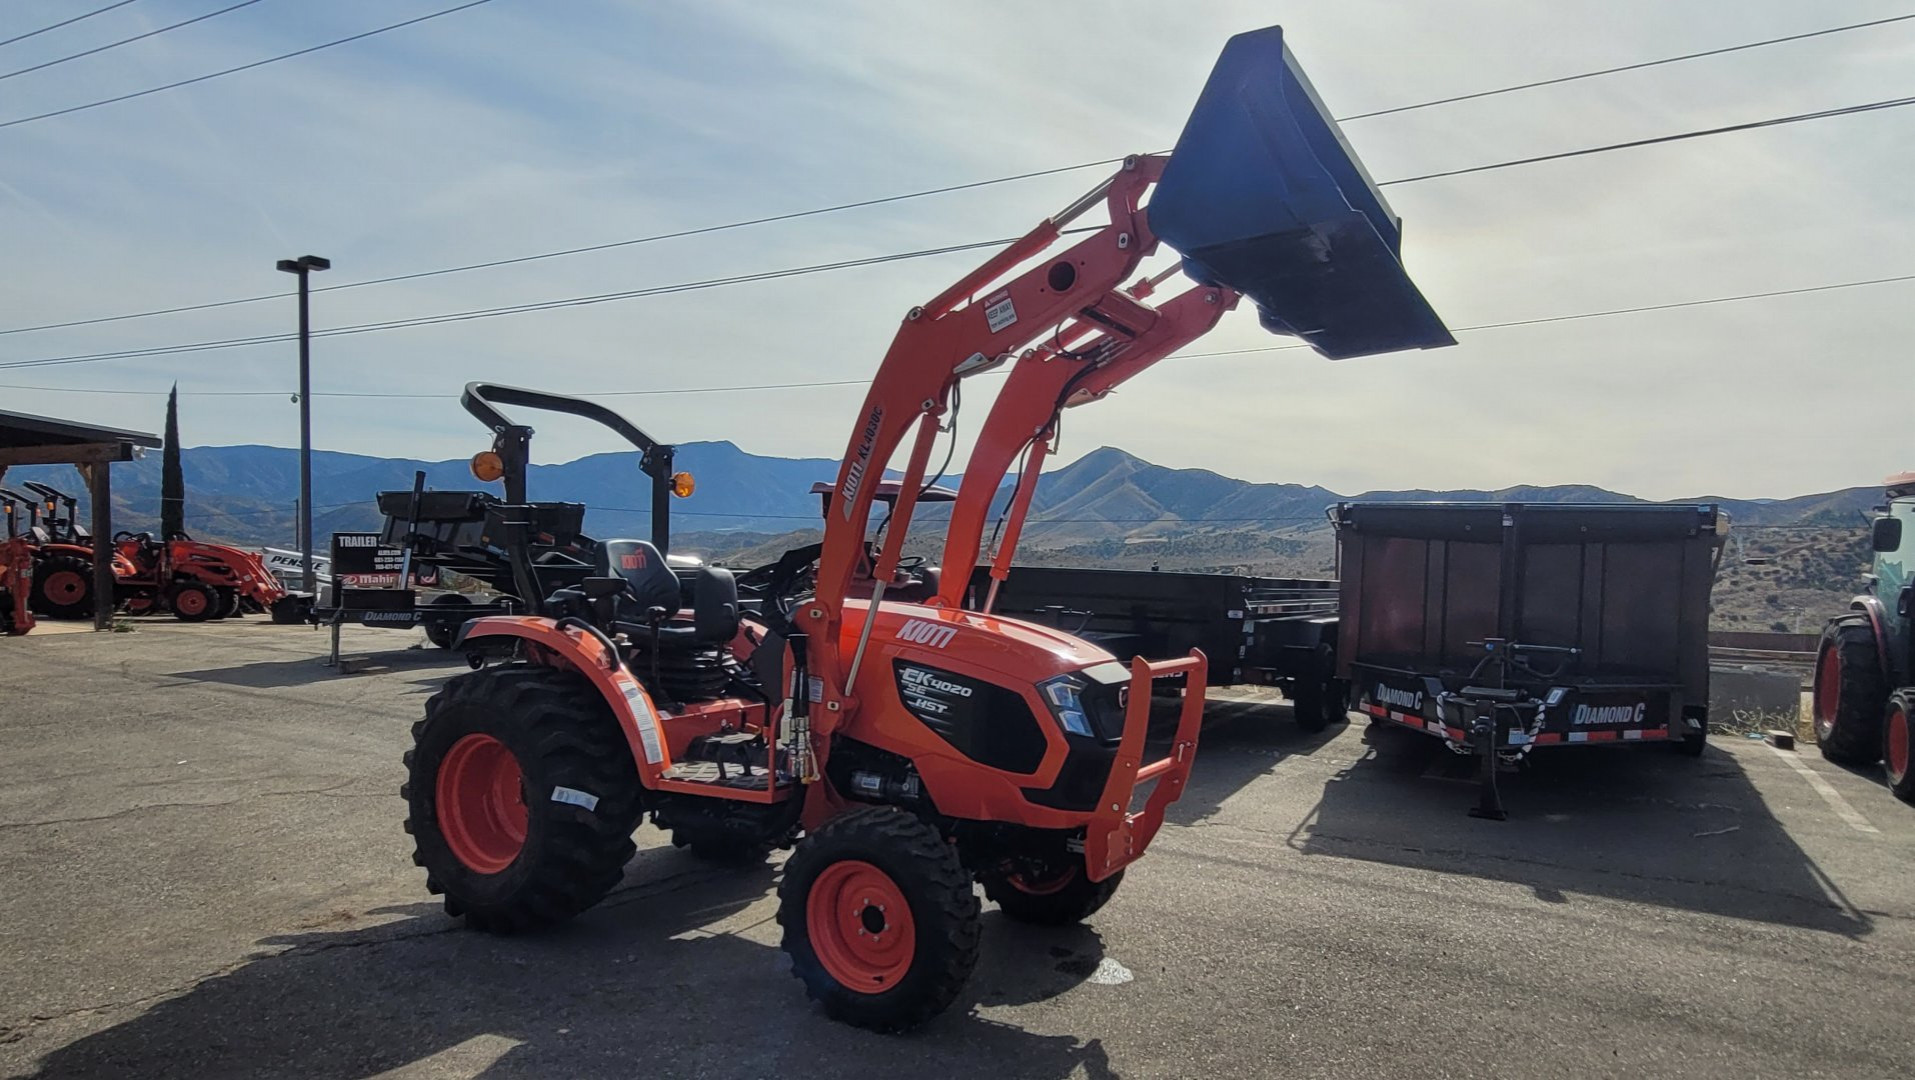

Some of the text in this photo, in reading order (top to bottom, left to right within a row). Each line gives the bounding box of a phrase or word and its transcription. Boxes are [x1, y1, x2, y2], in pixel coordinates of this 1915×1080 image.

[842, 462, 863, 501] KIOTI
[339, 536, 377, 547] TRAILER
[270, 555, 323, 570] PENSE
[365, 611, 411, 621] DIAMOND
[895, 619, 958, 648] KIOTI
[1378, 684, 1422, 709] DIAMOND C
[1575, 704, 1645, 725] DIAMOND C
